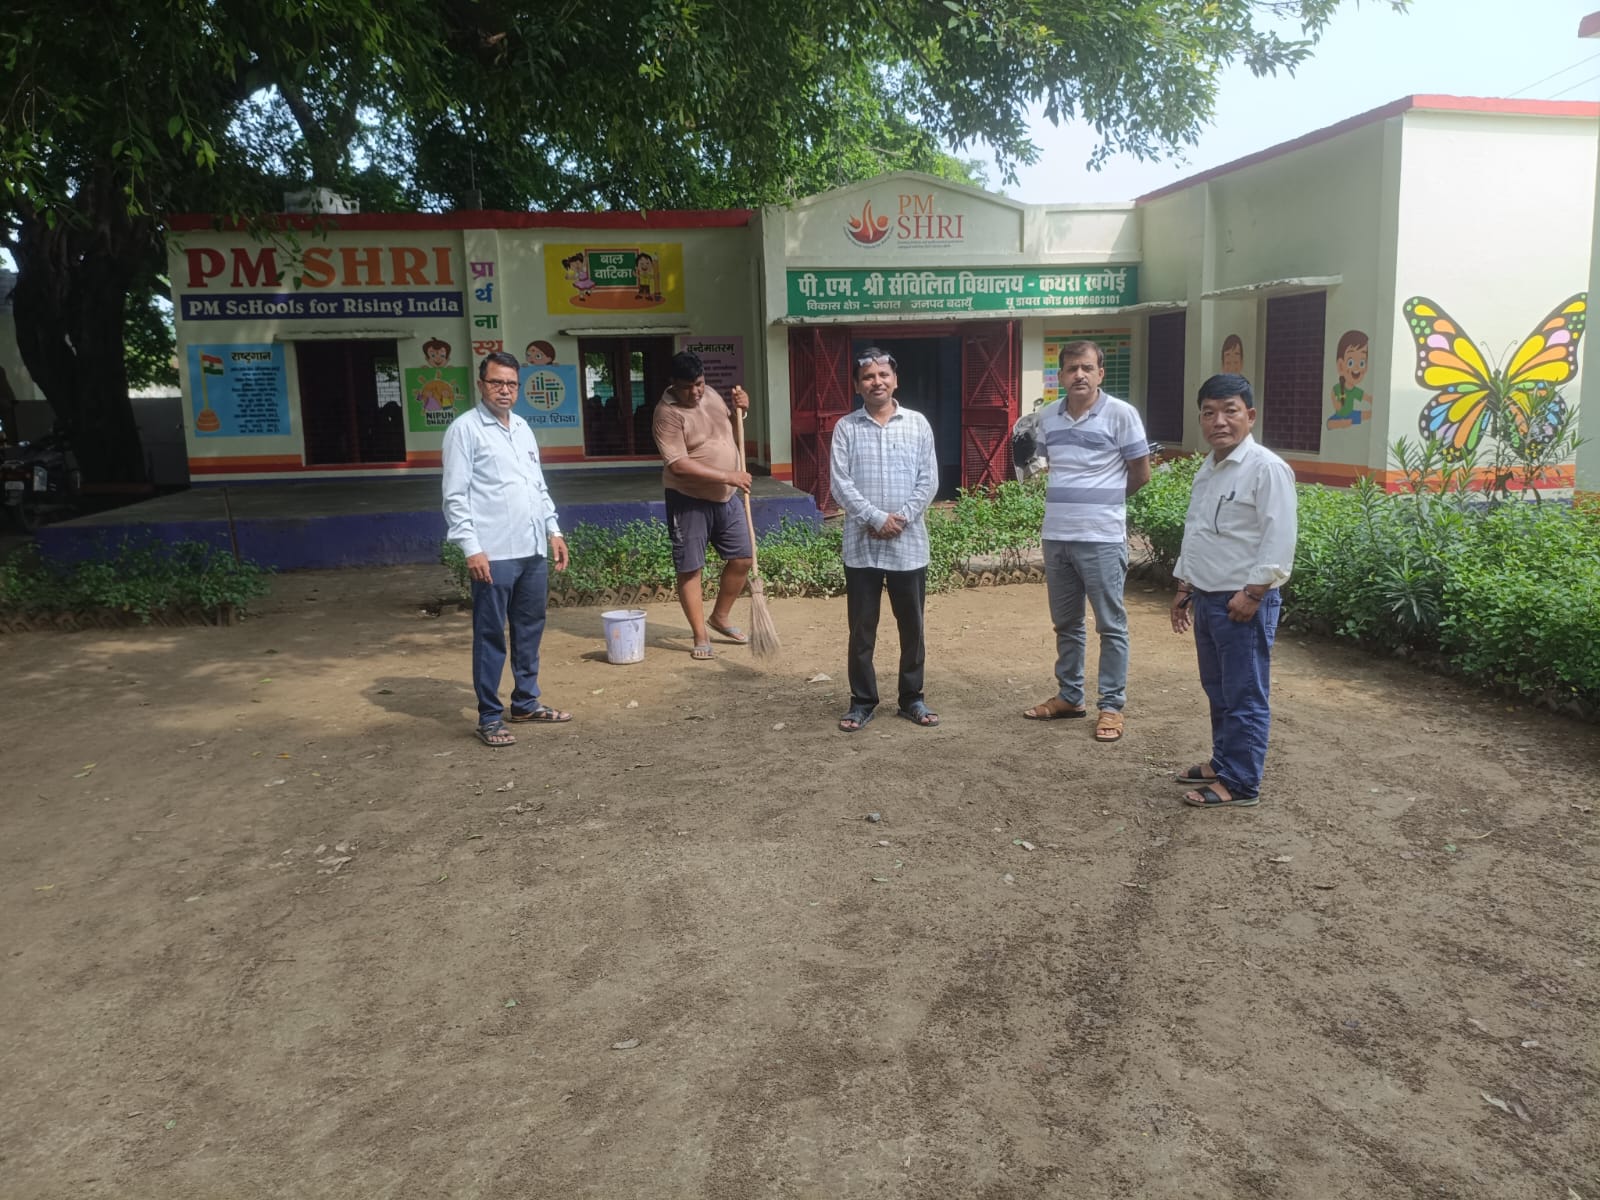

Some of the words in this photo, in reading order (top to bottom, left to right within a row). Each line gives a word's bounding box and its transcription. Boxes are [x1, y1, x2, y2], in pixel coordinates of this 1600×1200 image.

[897, 194, 934, 215] PM
[897, 215, 964, 239] SHRI
[184, 247, 282, 288] PM
[300, 247, 454, 288] SHRI
[600, 254, 624, 265] बाल
[594, 267, 633, 280] वाटिका
[862, 271, 884, 296] श्री
[888, 271, 955, 296] संविलित
[959, 270, 1024, 294] विद्यालय
[189, 300, 220, 316] PM
[309, 299, 338, 314] for
[342, 297, 403, 316] Rising
[408, 297, 459, 313] India
[806, 299, 840, 311] विकास
[843, 298, 860, 310] क्षेत्र
[872, 300, 901, 310] जगत
[911, 298, 944, 309] जनपद
[426, 411, 453, 419] NIPUN
[549, 412, 576, 423] शिक्षा
